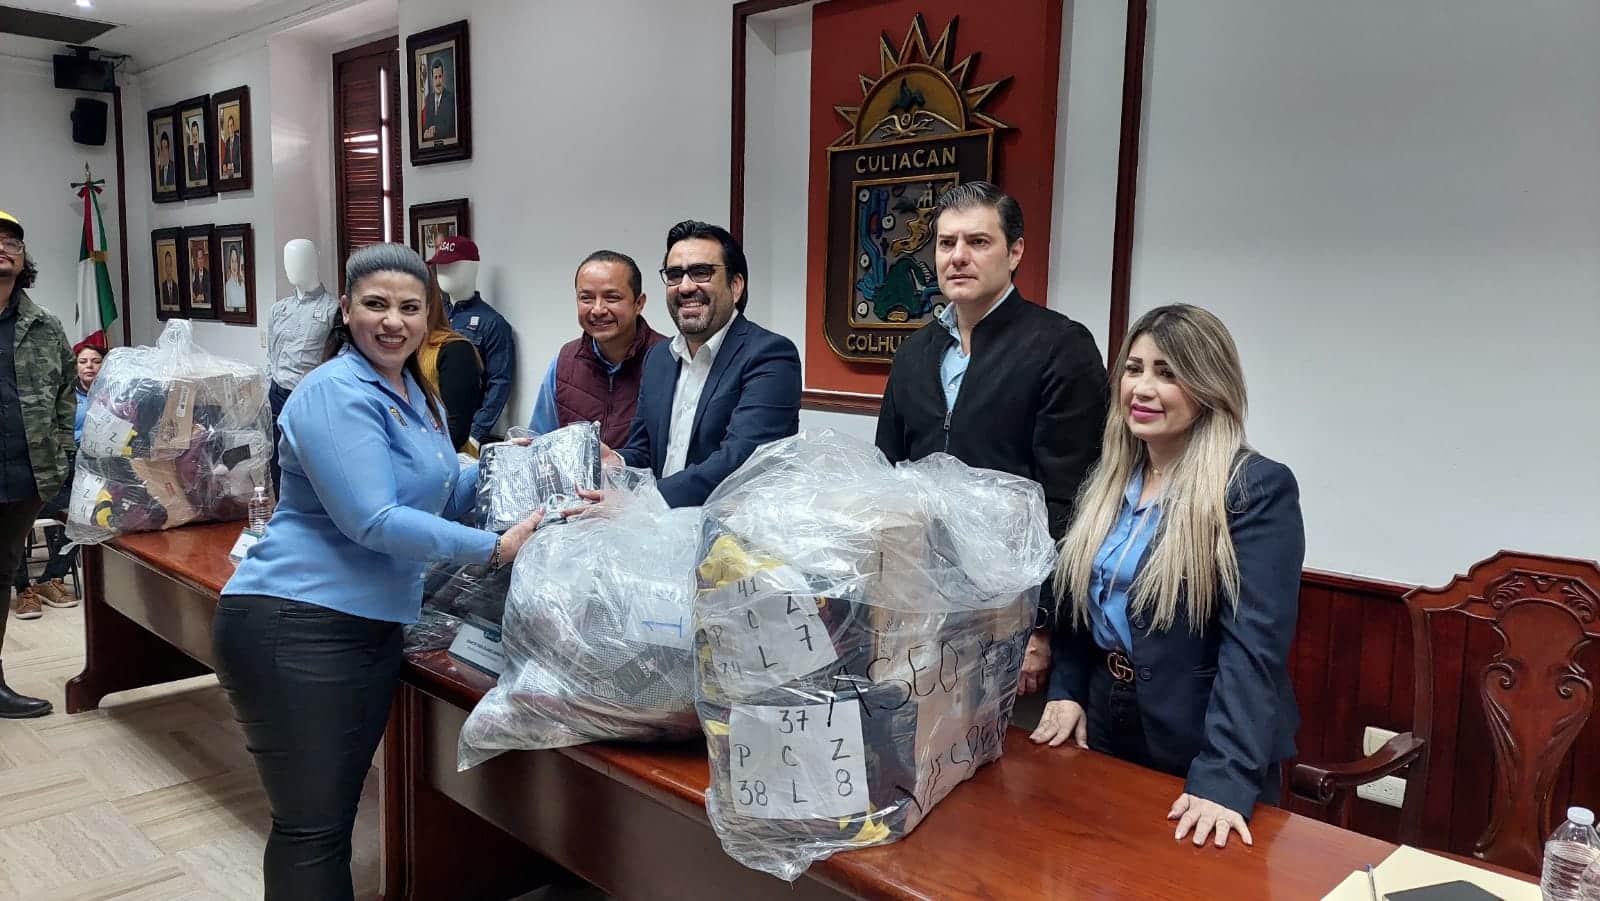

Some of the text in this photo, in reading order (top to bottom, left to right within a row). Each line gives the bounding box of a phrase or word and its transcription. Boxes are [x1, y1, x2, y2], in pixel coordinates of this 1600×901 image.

[855, 146, 956, 174] CULIACAN
[793, 623, 814, 652] 7
[778, 709, 809, 735] 37
[734, 743, 751, 768] P
[781, 744, 799, 767] C
[736, 768, 854, 807] 38 L 8
